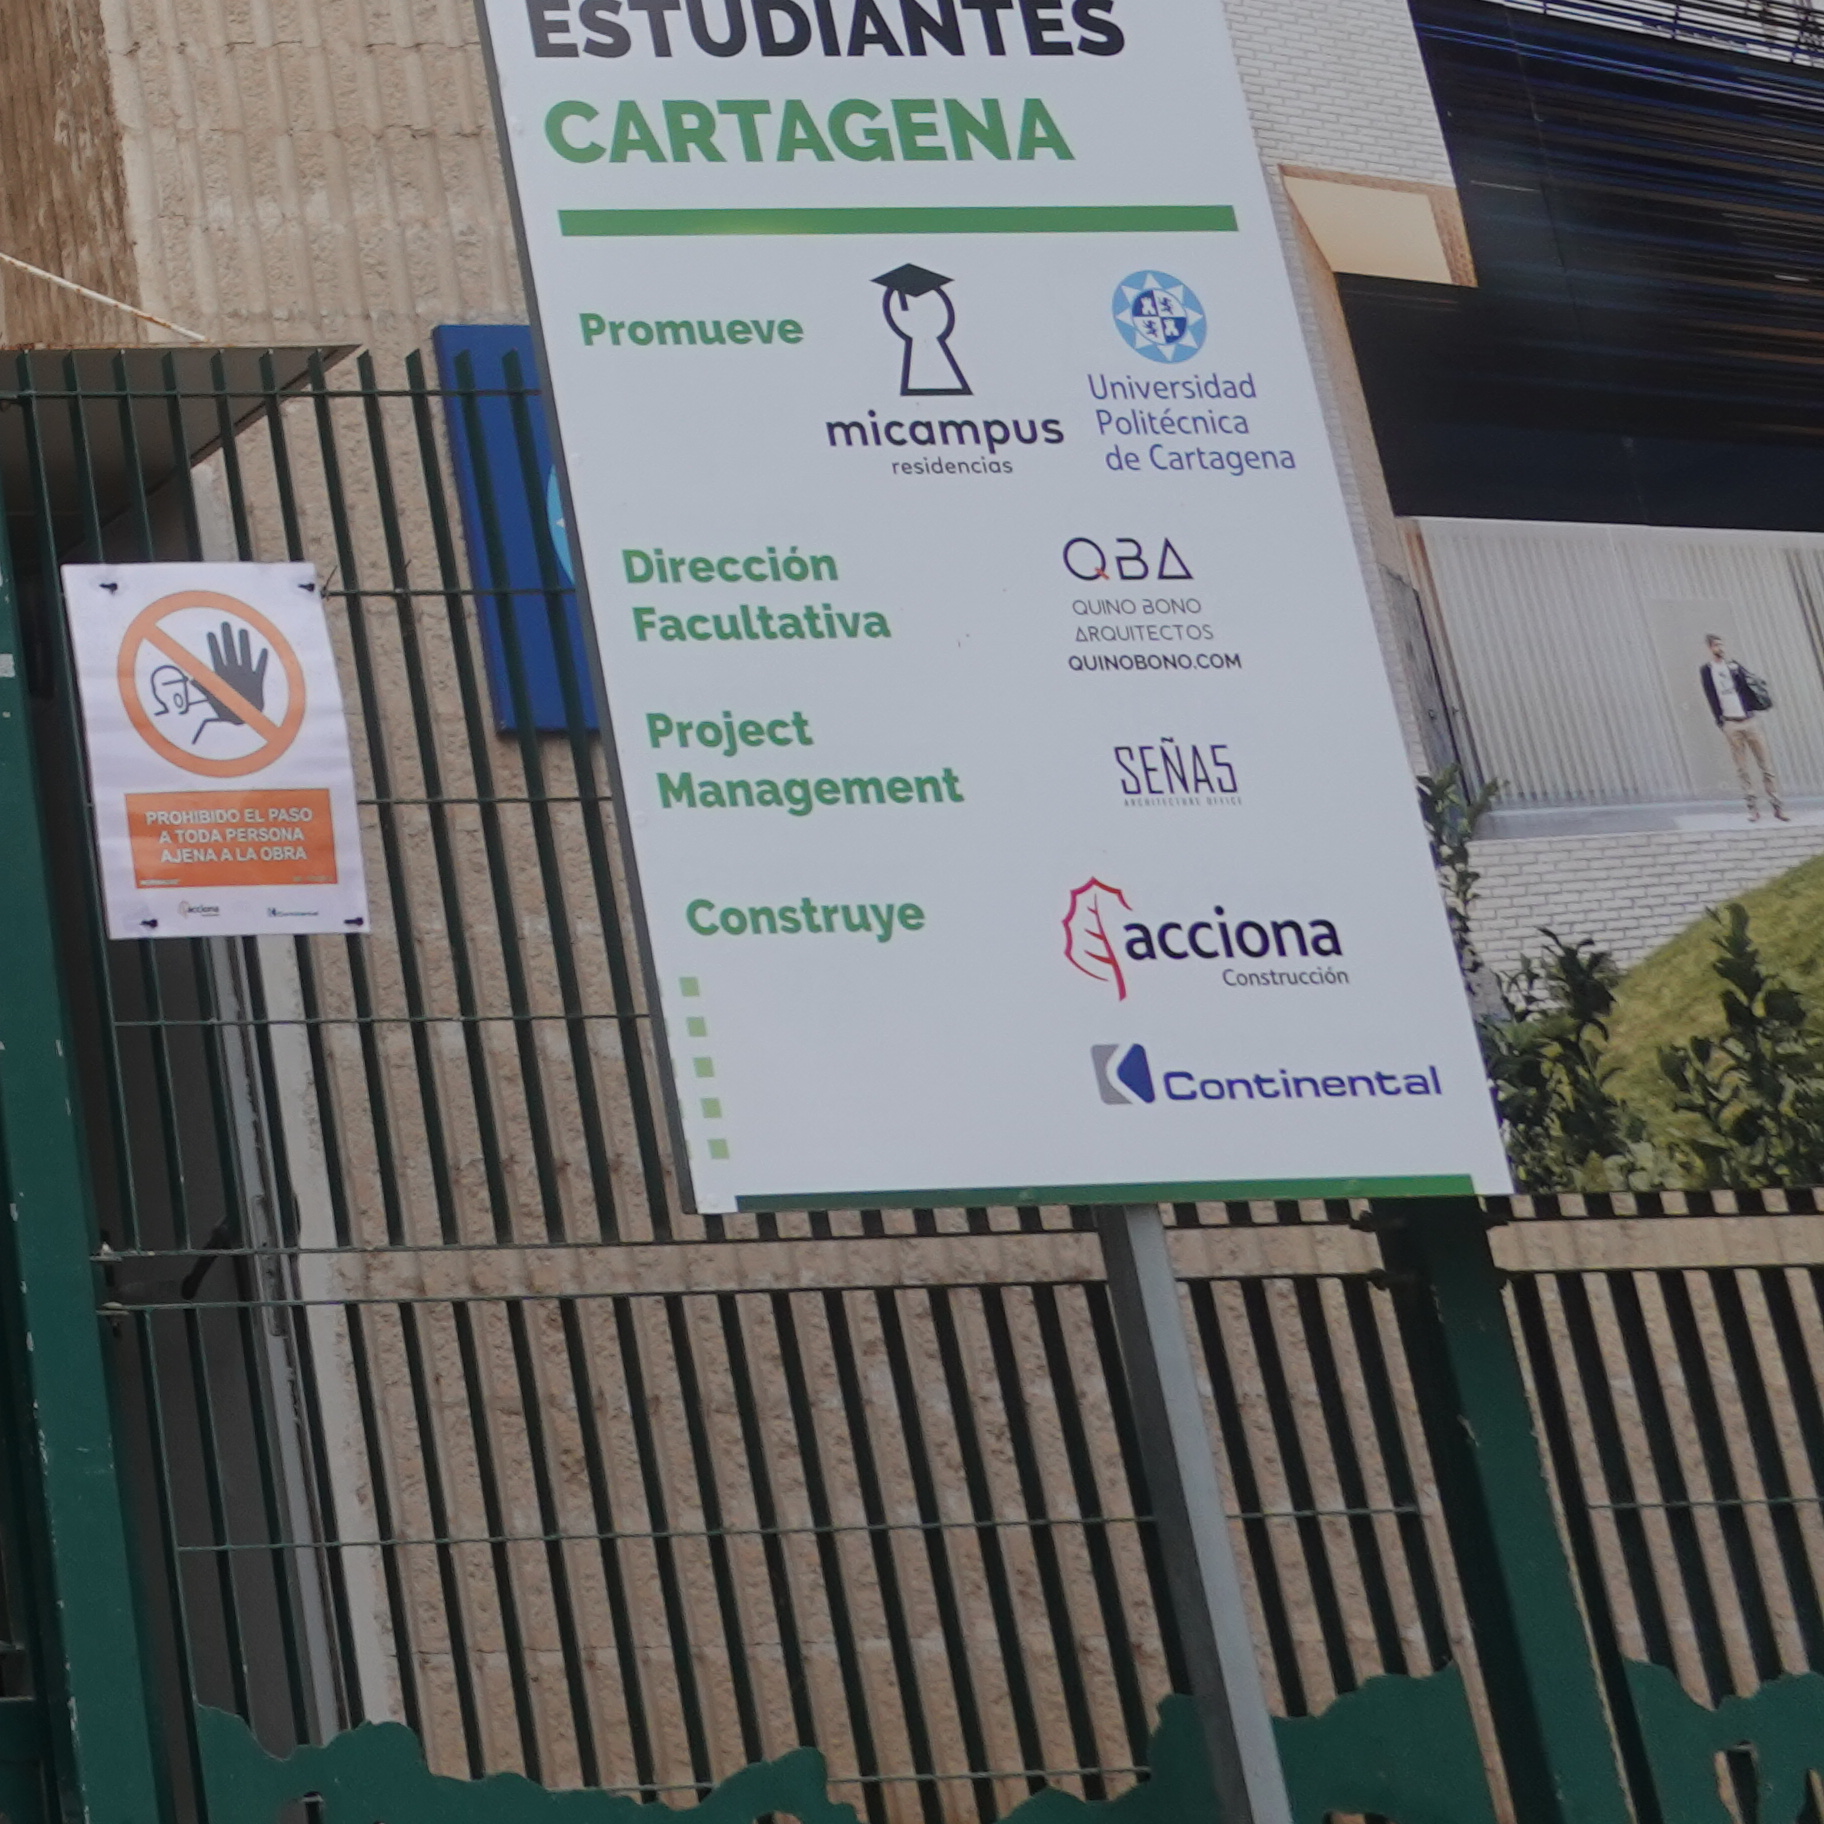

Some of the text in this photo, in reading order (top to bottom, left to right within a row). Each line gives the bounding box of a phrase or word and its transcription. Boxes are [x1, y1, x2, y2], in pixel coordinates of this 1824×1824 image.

[544, 98, 1076, 164] CARTAGENA
[579, 312, 804, 346] Promueve
[1087, 372, 1258, 401] Universidad
[825, 409, 1065, 455] micampus
[1095, 407, 1250, 437] Politécnica
[892, 455, 1014, 476] residencias
[1105, 443, 1297, 477] de Cartagena
[621, 545, 840, 585] Dirección
[1062, 536, 1195, 581] QBA
[632, 603, 892, 643] Facultativa
[1072, 598, 1202, 616] QUINO BONO
[1075, 624, 1214, 643] ARQUITECTOS
[1068, 653, 1243, 672] QUINOBONO.COM
[645, 709, 814, 758] Project
[1114, 736, 1238, 795] SEÑAS
[656, 767, 965, 817] Management
[146, 807, 313, 826] PROHIBIDO EL PASO
[159, 827, 305, 844] A TODA PERSONA
[161, 846, 307, 864] AJENA A LA OBRA
[686, 896, 926, 944] Construye
[1123, 905, 1344, 961] acciona
[1222, 966, 1350, 987] Construcción
[1162, 1065, 1444, 1102] Continental
